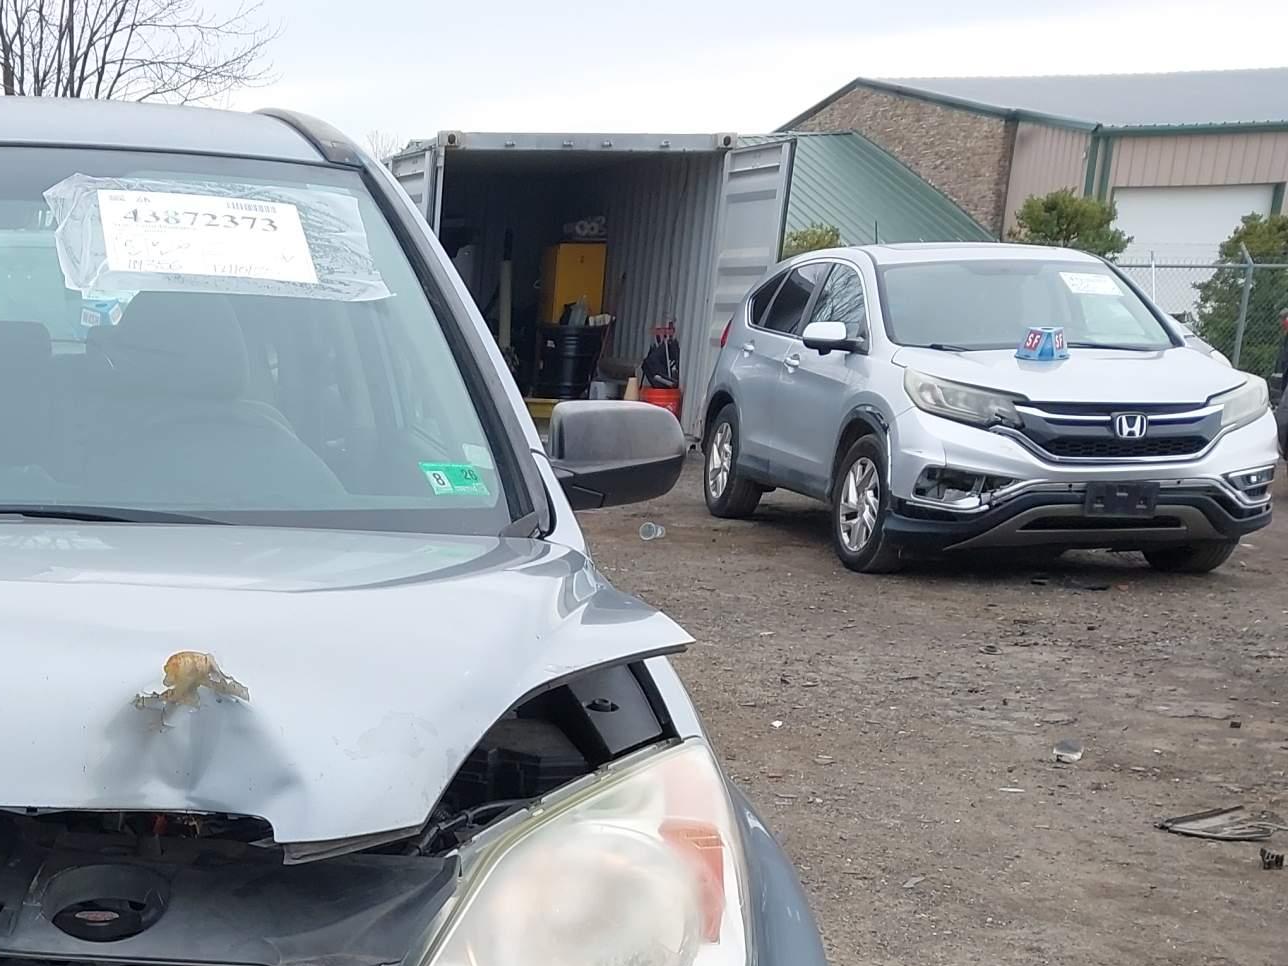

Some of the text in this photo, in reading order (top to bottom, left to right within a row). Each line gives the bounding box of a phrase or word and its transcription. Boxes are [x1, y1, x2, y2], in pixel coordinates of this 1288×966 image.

[122, 207, 279, 233] 43872373
[1026, 333, 1041, 348] SF
[432, 472, 446, 487] 8
